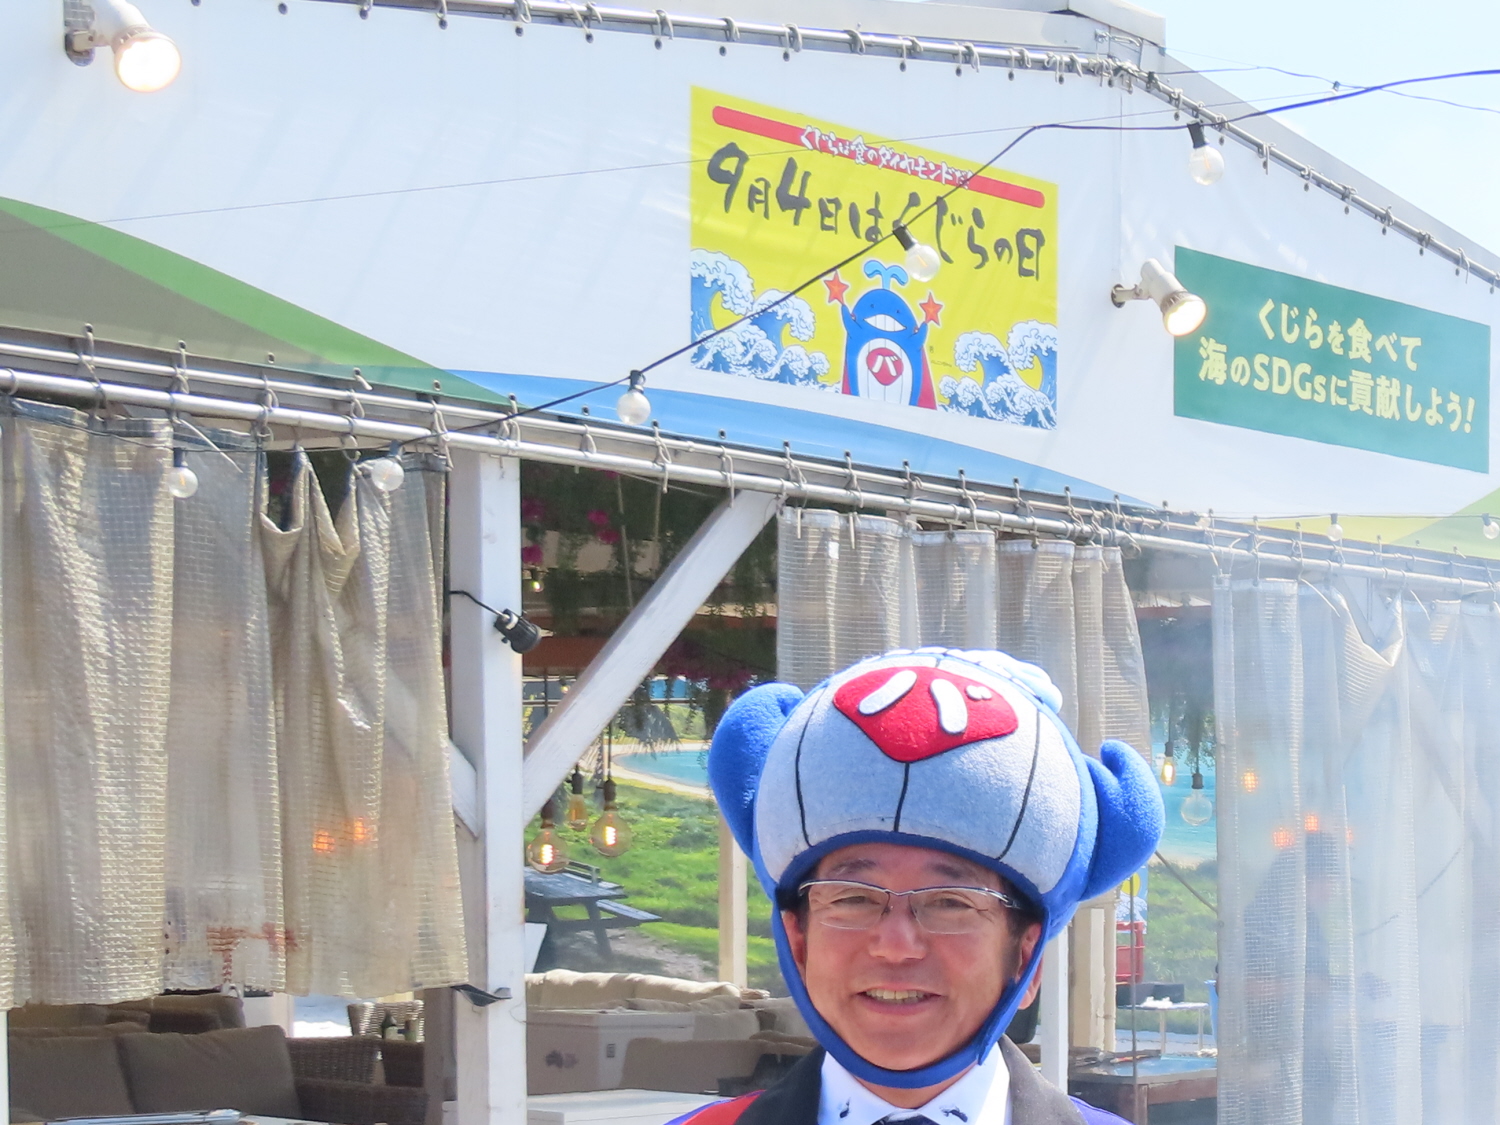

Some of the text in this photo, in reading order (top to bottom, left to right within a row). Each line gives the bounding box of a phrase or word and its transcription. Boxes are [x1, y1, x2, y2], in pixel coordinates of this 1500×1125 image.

[1258, 298, 1422, 371] くじらを食べて
[1198, 336, 1476, 433] 海のSDGsに貢献しよう!
